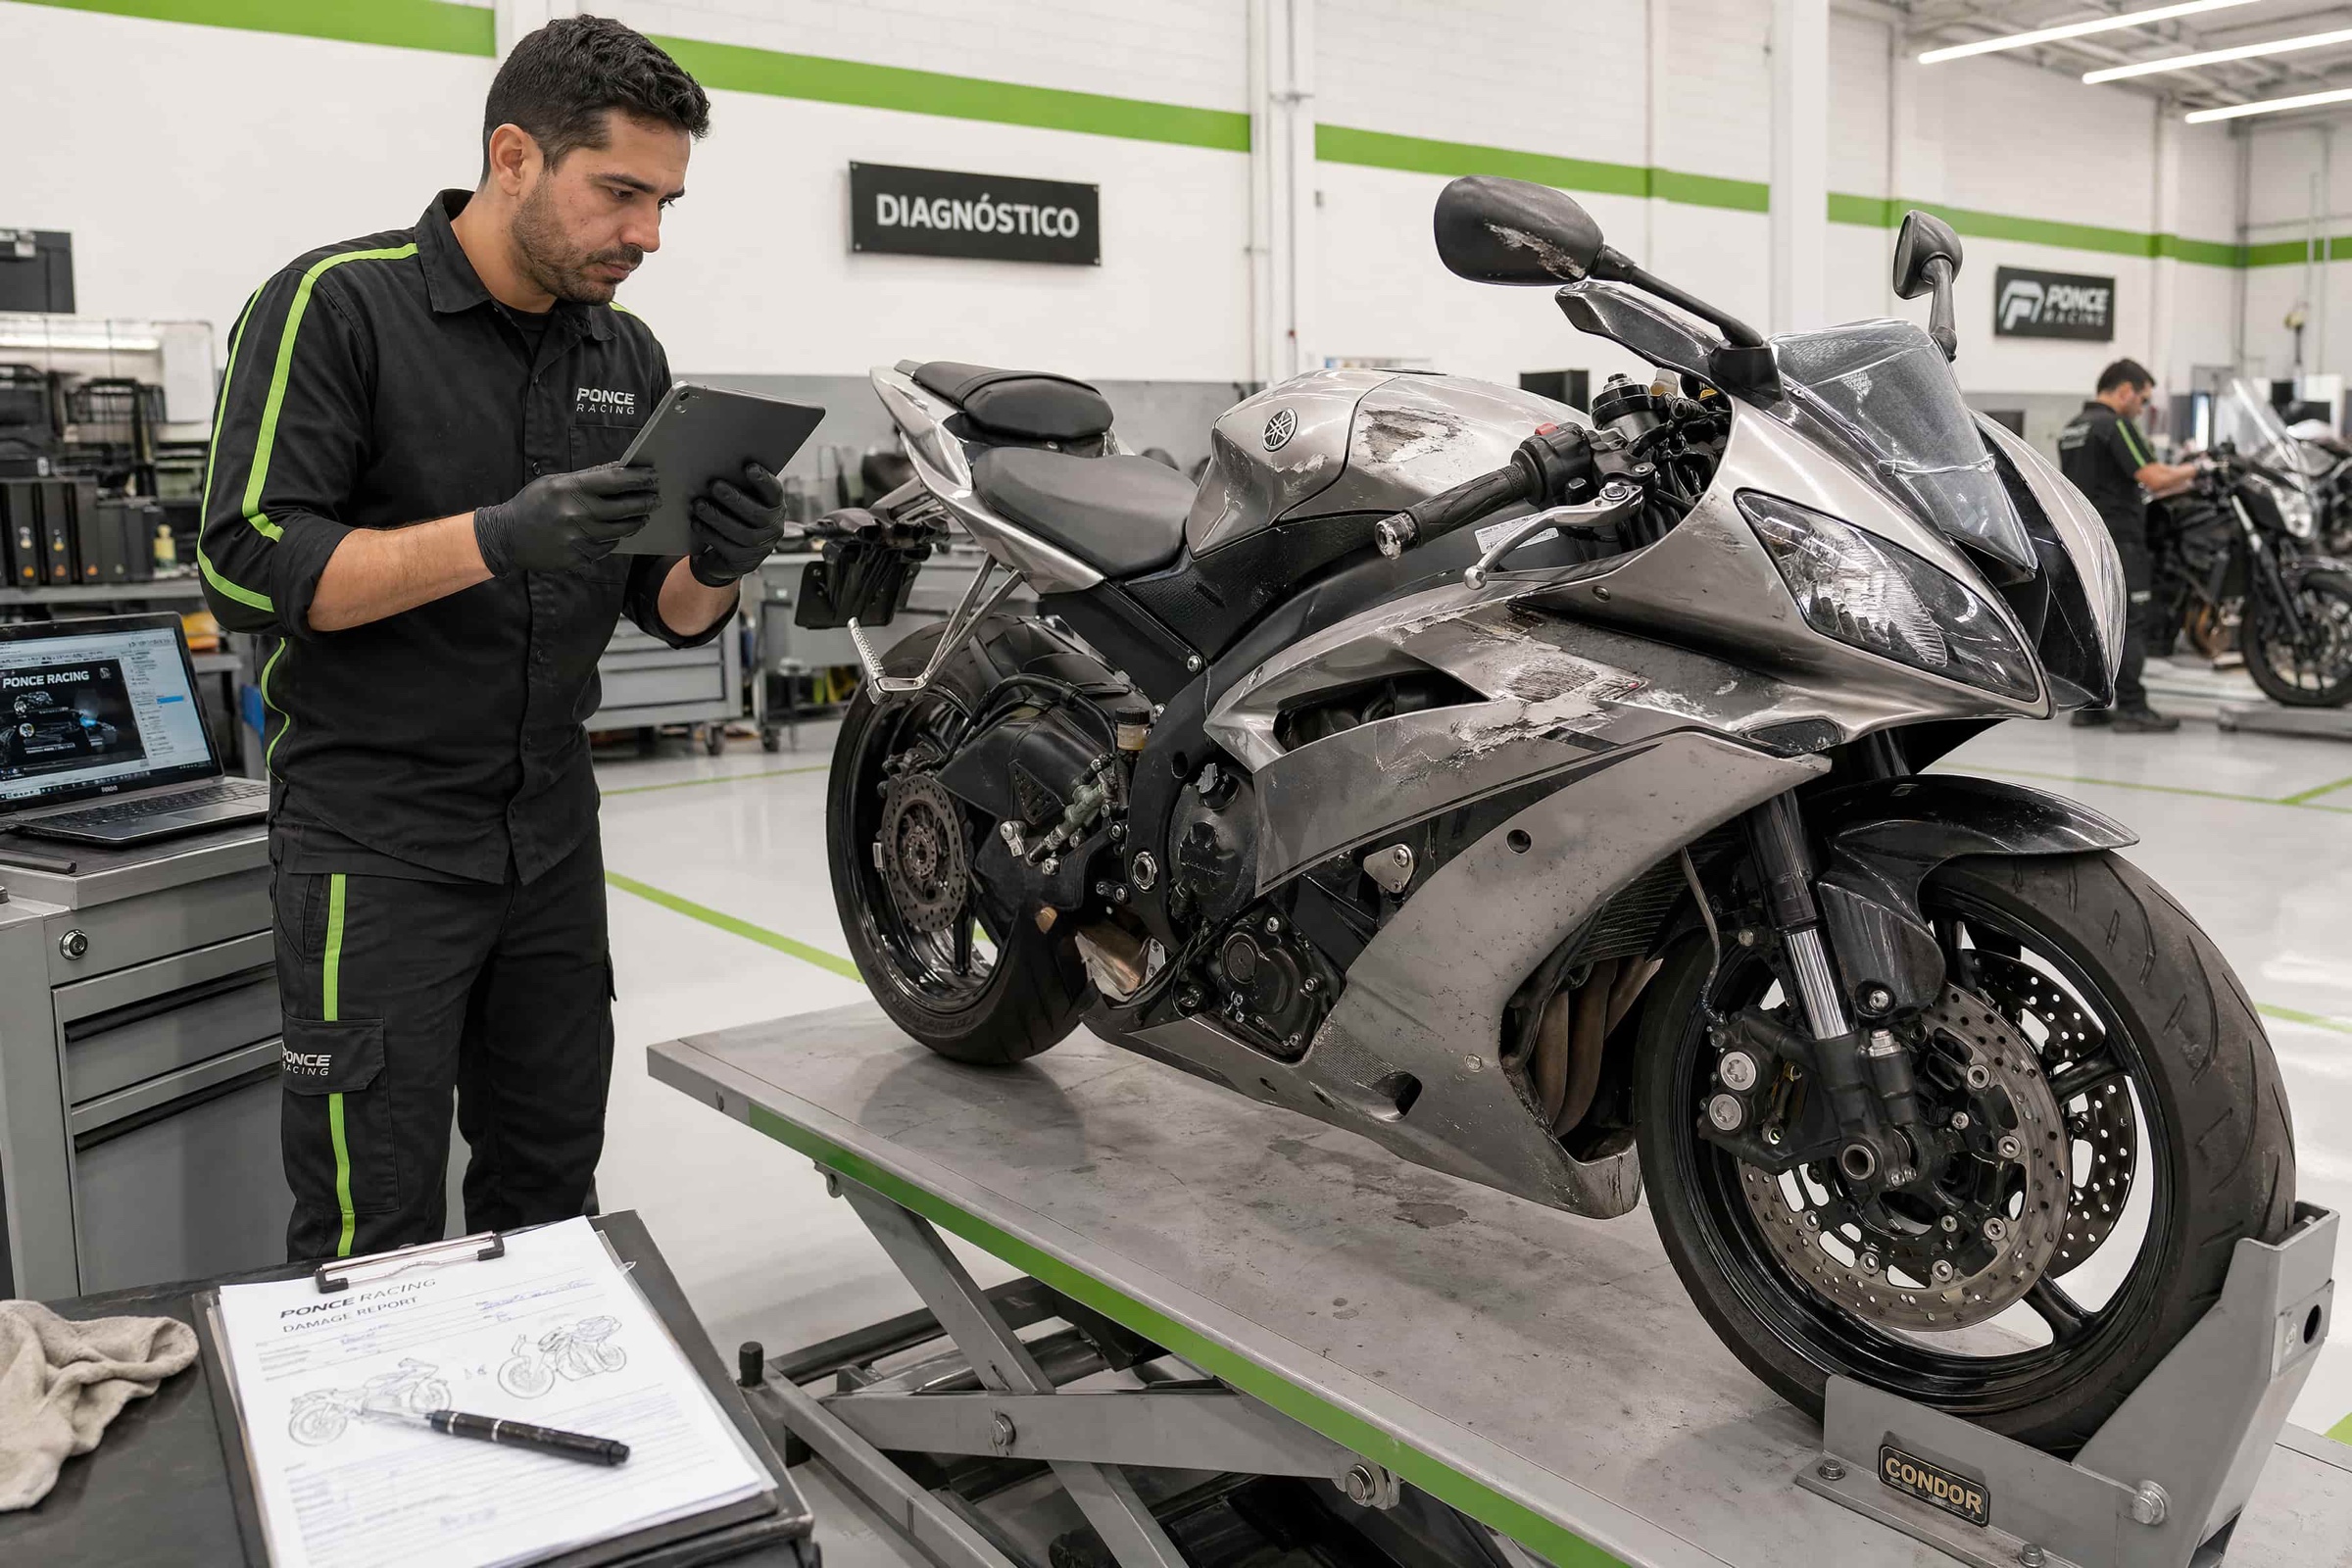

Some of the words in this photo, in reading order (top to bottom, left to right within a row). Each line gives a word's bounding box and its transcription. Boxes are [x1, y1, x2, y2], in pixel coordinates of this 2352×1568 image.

[876, 192, 1080, 238] DIAGNÓSTICO
[2044, 283, 2110, 312] PONCE
[2042, 309, 2106, 326] RACING
[576, 387, 635, 405] PONCE
[576, 403, 635, 415] RACING
[2, 675, 45, 688] PONCE
[46, 670, 90, 684] RACING
[279, 1297, 356, 1319] PONCE
[360, 1278, 436, 1301] RACING
[282, 1313, 352, 1333] DAMAGE
[356, 1297, 418, 1316] REPORT
[1886, 1457, 1983, 1514] CONDOR
